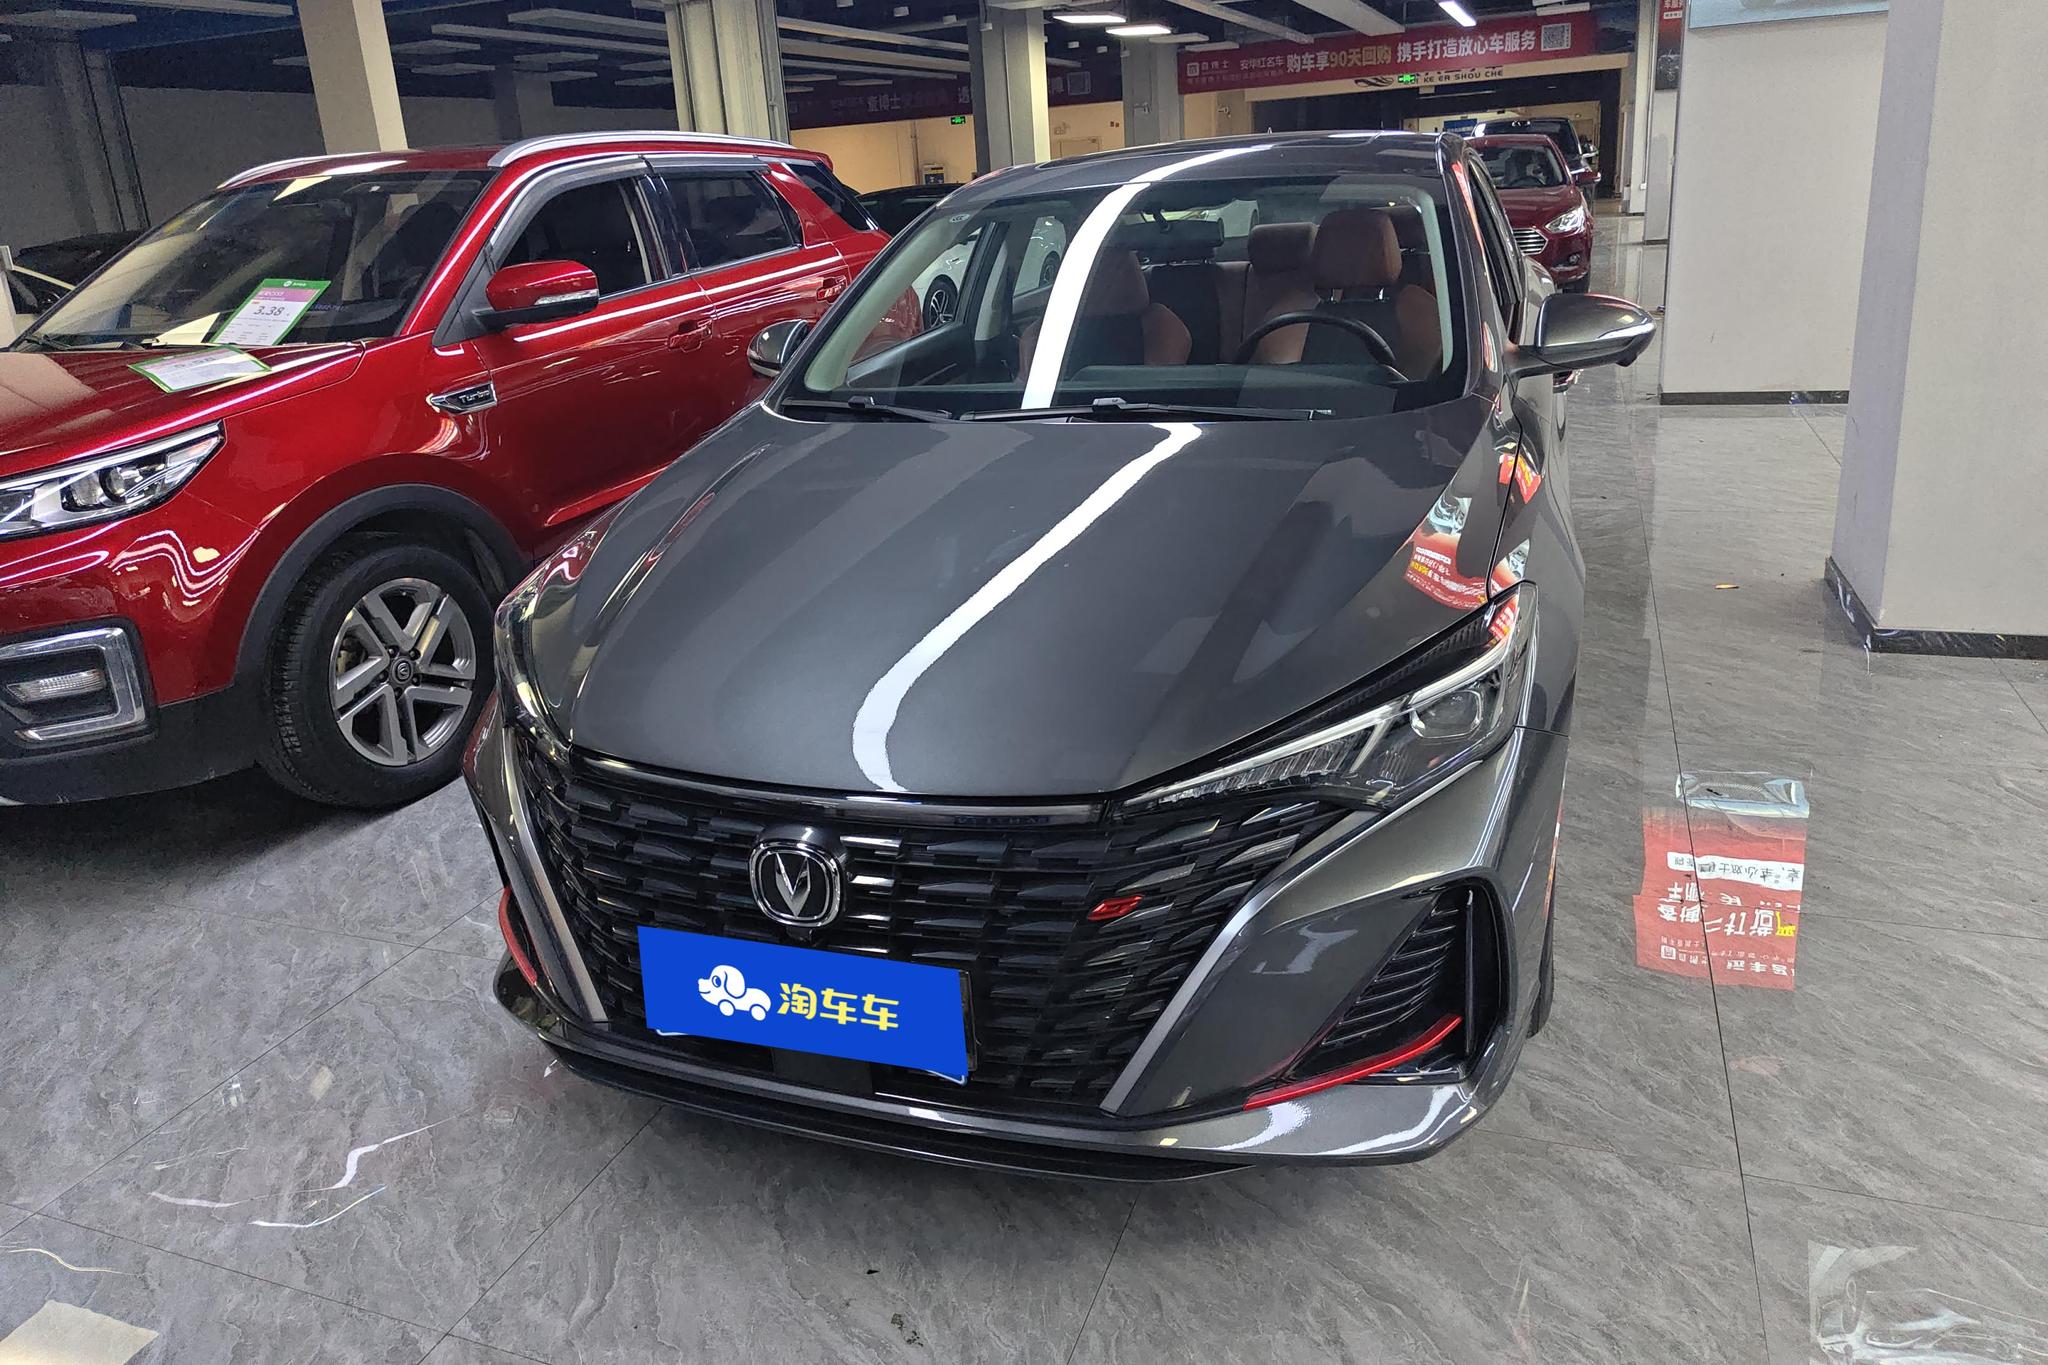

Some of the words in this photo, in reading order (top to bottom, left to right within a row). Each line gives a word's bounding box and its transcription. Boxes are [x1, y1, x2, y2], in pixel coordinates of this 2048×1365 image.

[1287, 45, 1391, 73] 购车享90天回购
[1397, 29, 1537, 63] 携手打造放心车服务
[1454, 71, 1480, 80] SHOU
[1485, 69, 1503, 77] CHE
[253, 306, 285, 316] 3.38
